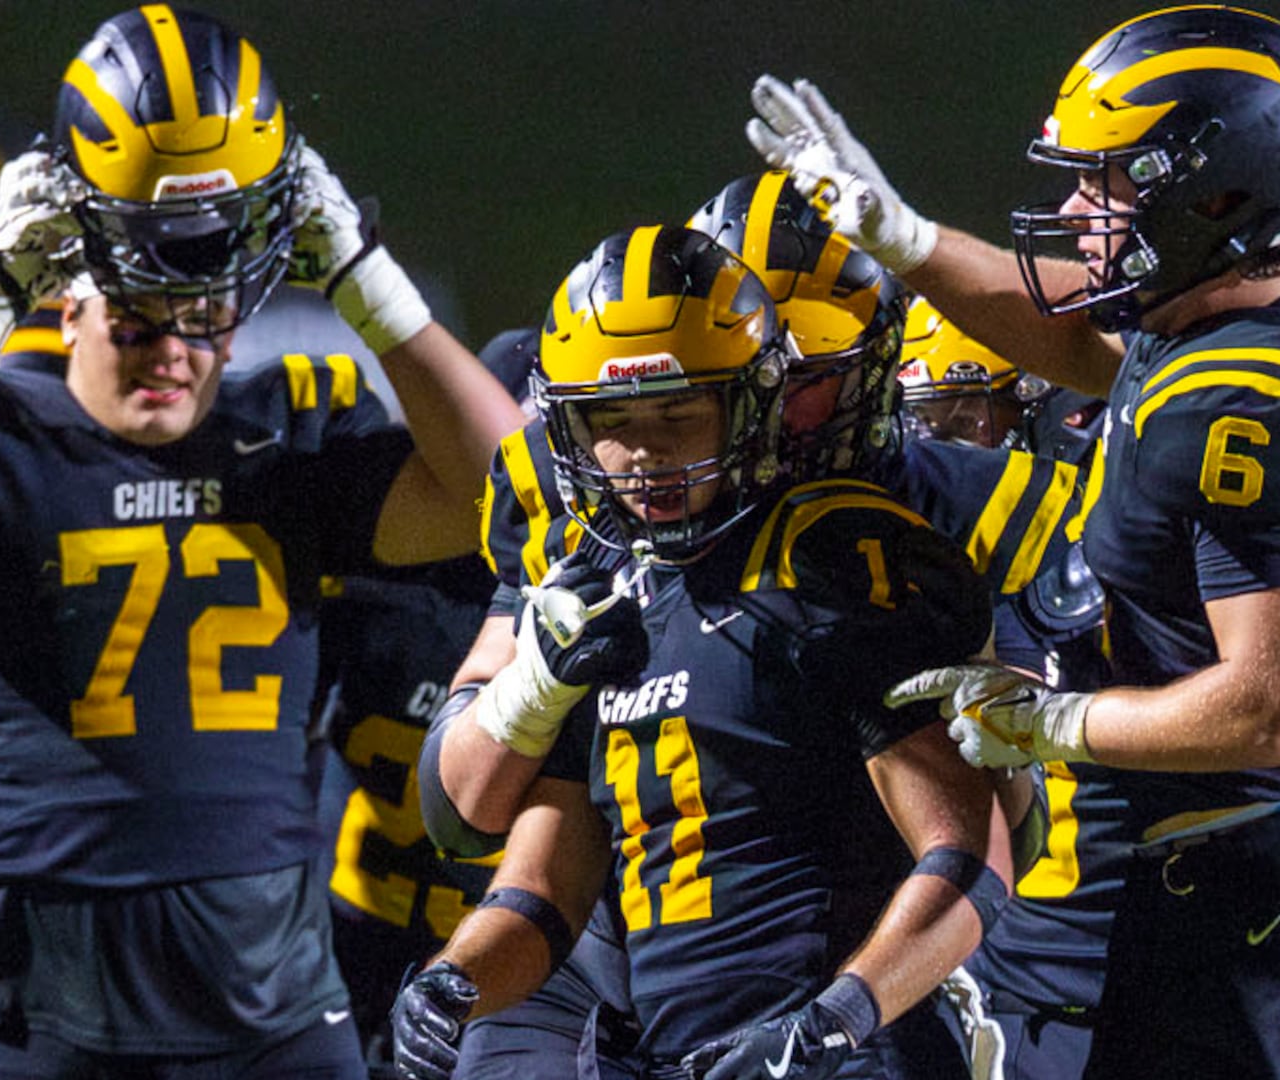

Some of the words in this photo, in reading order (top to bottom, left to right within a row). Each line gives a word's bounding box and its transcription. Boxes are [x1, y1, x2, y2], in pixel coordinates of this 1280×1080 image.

[607, 359, 671, 378] Riddell
[113, 479, 223, 521] CHIEFS
[1199, 416, 1271, 507] 6
[58, 521, 290, 740] 72
[604, 715, 714, 933] 11
